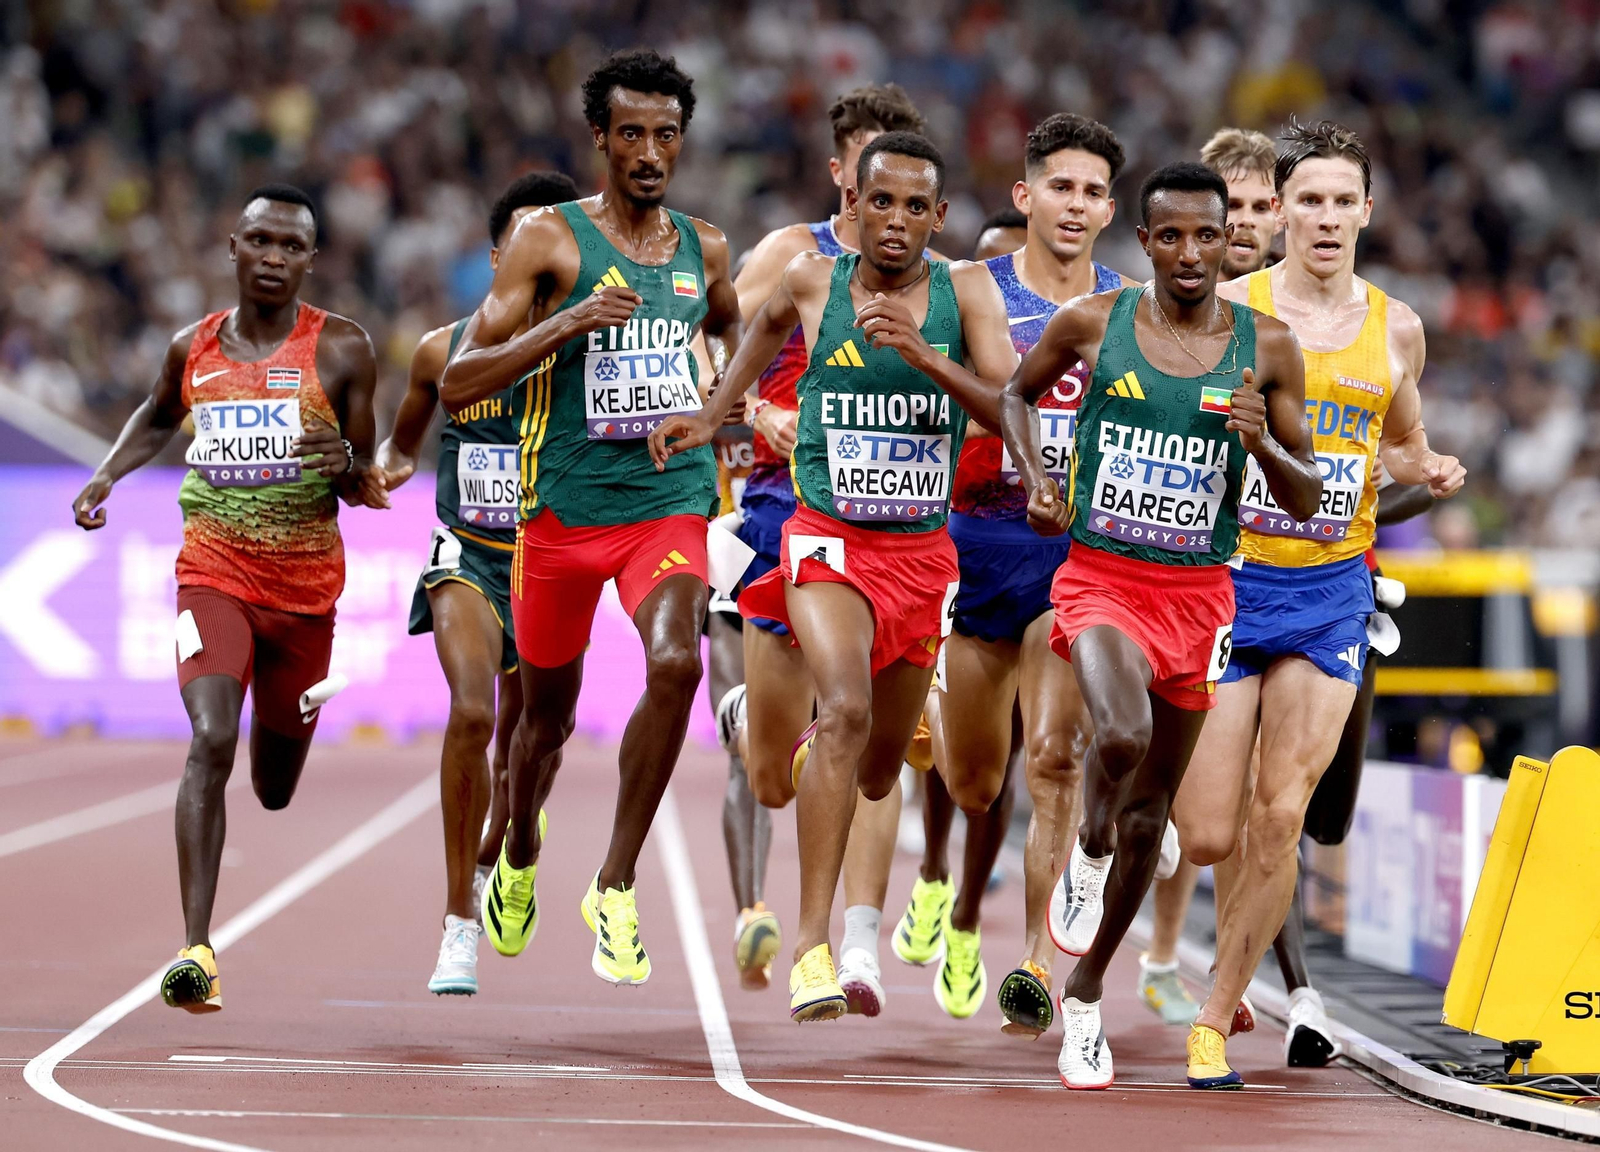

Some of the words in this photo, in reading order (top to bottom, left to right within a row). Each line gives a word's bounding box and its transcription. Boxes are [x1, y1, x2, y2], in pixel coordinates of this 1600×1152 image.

[619, 352, 683, 380] TDK
[592, 383, 697, 414] KEJELCHA
[1339, 376, 1384, 396] BAUHAUS
[211, 404, 289, 429] TDK
[821, 392, 950, 426] ETHIOPIA
[1305, 399, 1376, 443] EDEN
[619, 420, 664, 434] TOK
[862, 435, 943, 464] TDK
[1098, 420, 1229, 473] ETHIOPIA
[837, 467, 944, 497] AREGAWI
[1136, 457, 1217, 495] TDK
[1315, 457, 1359, 484] DK
[1100, 482, 1210, 527] BAREGA
[1246, 479, 1358, 517] ALREN
[1218, 630, 1232, 670] 8
[1518, 762, 1542, 774] SEIKO
